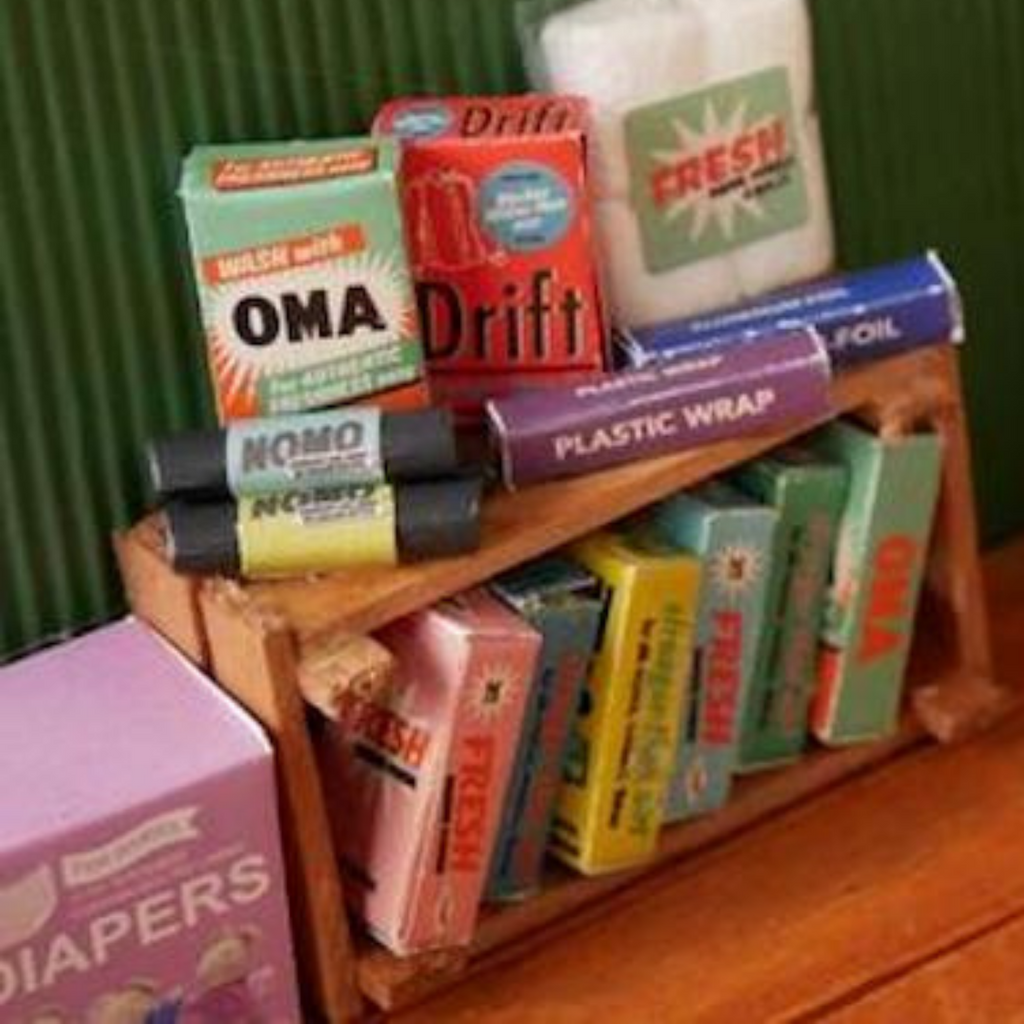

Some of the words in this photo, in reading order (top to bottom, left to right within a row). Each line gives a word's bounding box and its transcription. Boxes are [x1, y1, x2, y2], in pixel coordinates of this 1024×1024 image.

[461, 102, 568, 138] Drift
[650, 120, 787, 209] FRESH
[231, 284, 387, 347] OMA
[415, 270, 582, 360] Drift
[829, 318, 901, 349] FOIL
[242, 420, 364, 474] NOMO
[554, 411, 679, 460] PLASTIC
[682, 388, 777, 430] WRAP
[857, 533, 917, 666] OMA
[452, 734, 495, 873] FRESH
